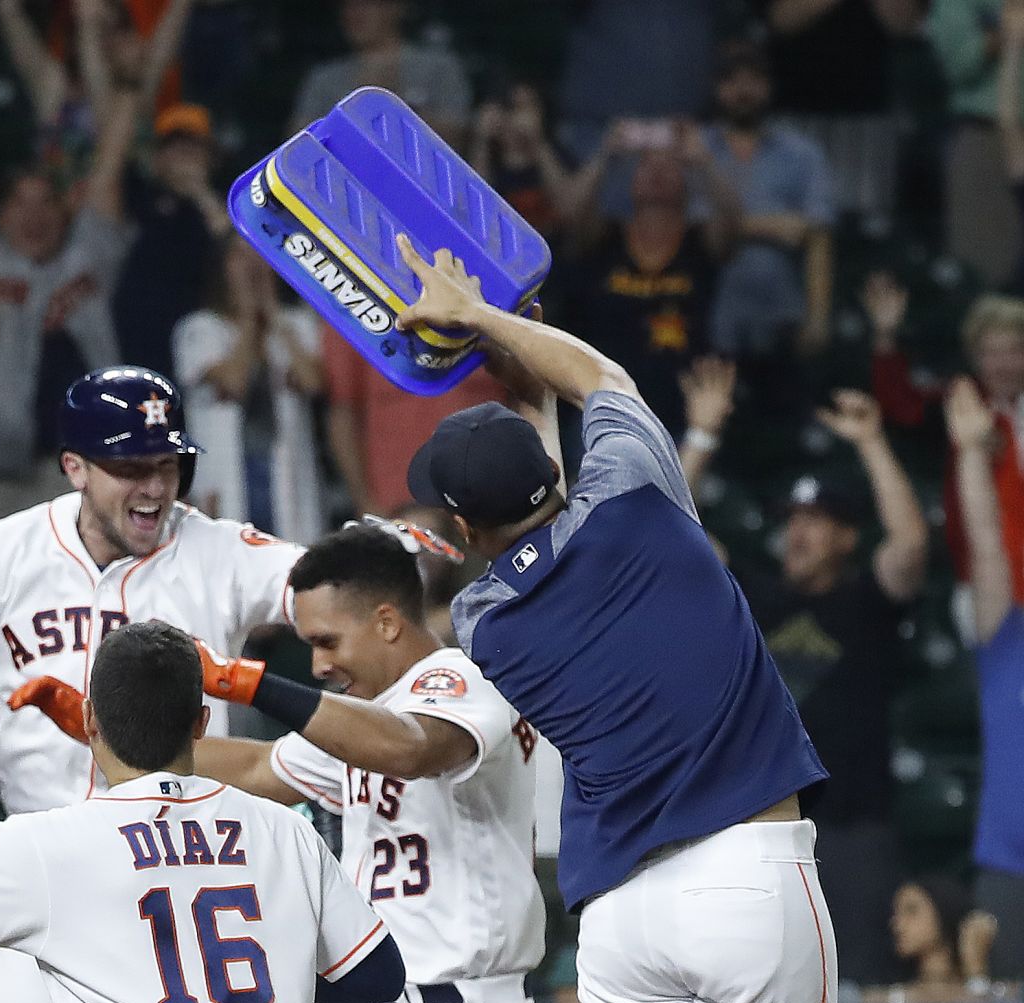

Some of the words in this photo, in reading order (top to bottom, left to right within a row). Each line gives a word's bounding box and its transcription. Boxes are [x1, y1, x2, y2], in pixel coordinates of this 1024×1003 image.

[284, 233, 394, 336] GIANTS
[117, 805, 247, 871] DÍAZ
[371, 833, 431, 901] 23
